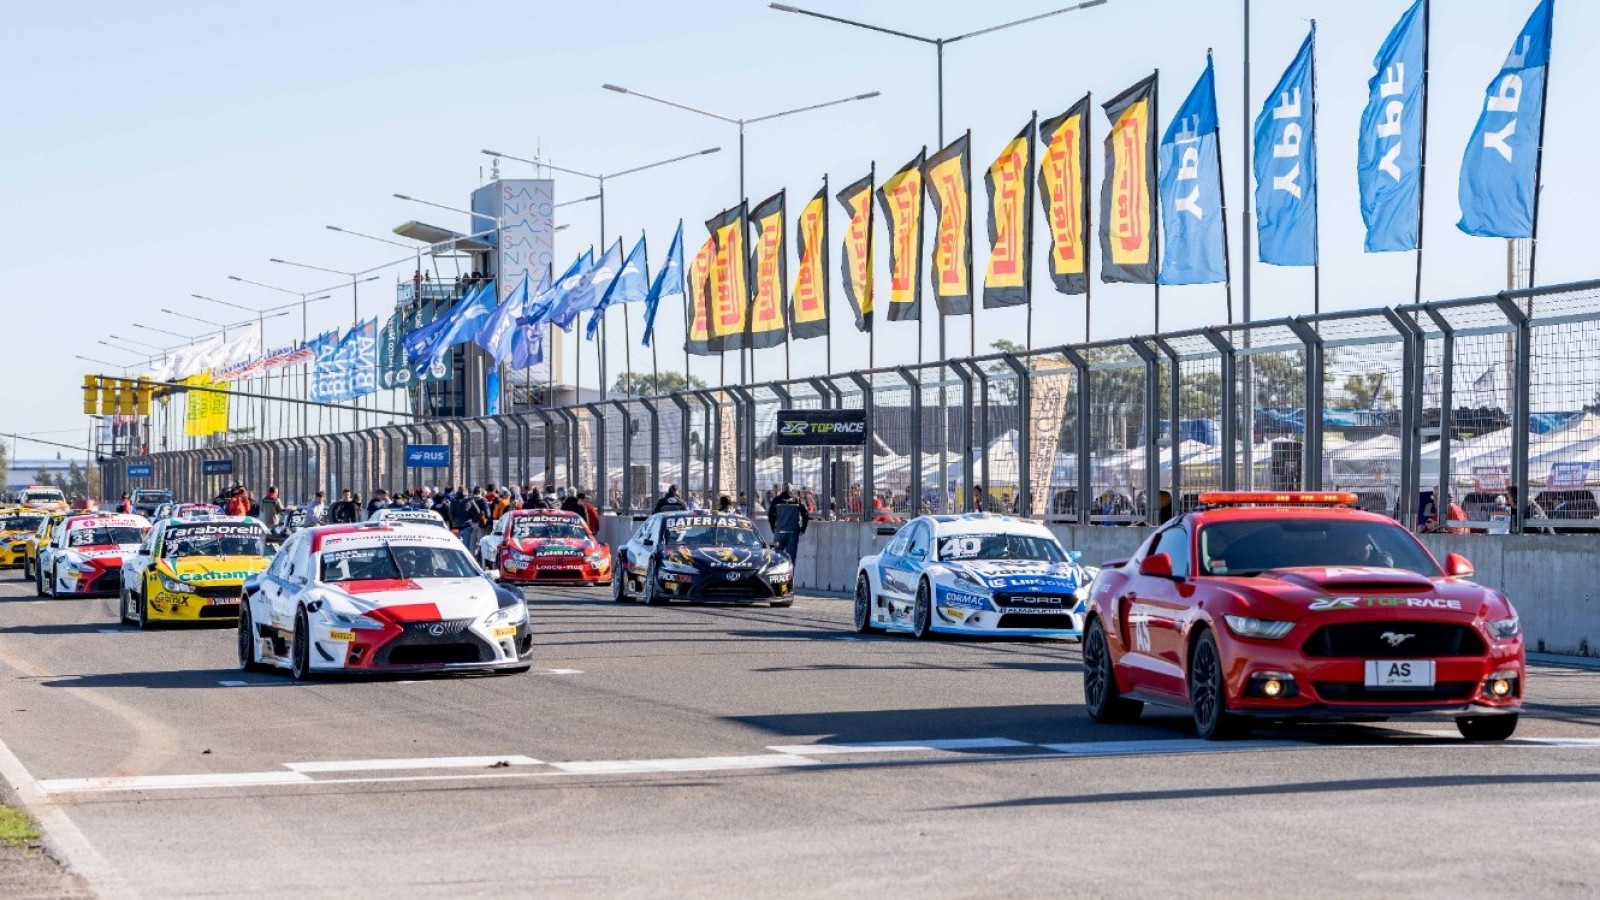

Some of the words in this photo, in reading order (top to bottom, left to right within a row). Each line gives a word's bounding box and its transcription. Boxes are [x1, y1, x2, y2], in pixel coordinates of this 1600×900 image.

[423, 451, 444, 461] RUS
[165, 525, 262, 539] Taraborelli
[676, 530, 687, 542] 7
[940, 538, 982, 558] 40
[336, 559, 351, 580] 1
[946, 592, 985, 605] CORMAC
[1010, 596, 1062, 604] FORD
[1388, 663, 1411, 677] AS
